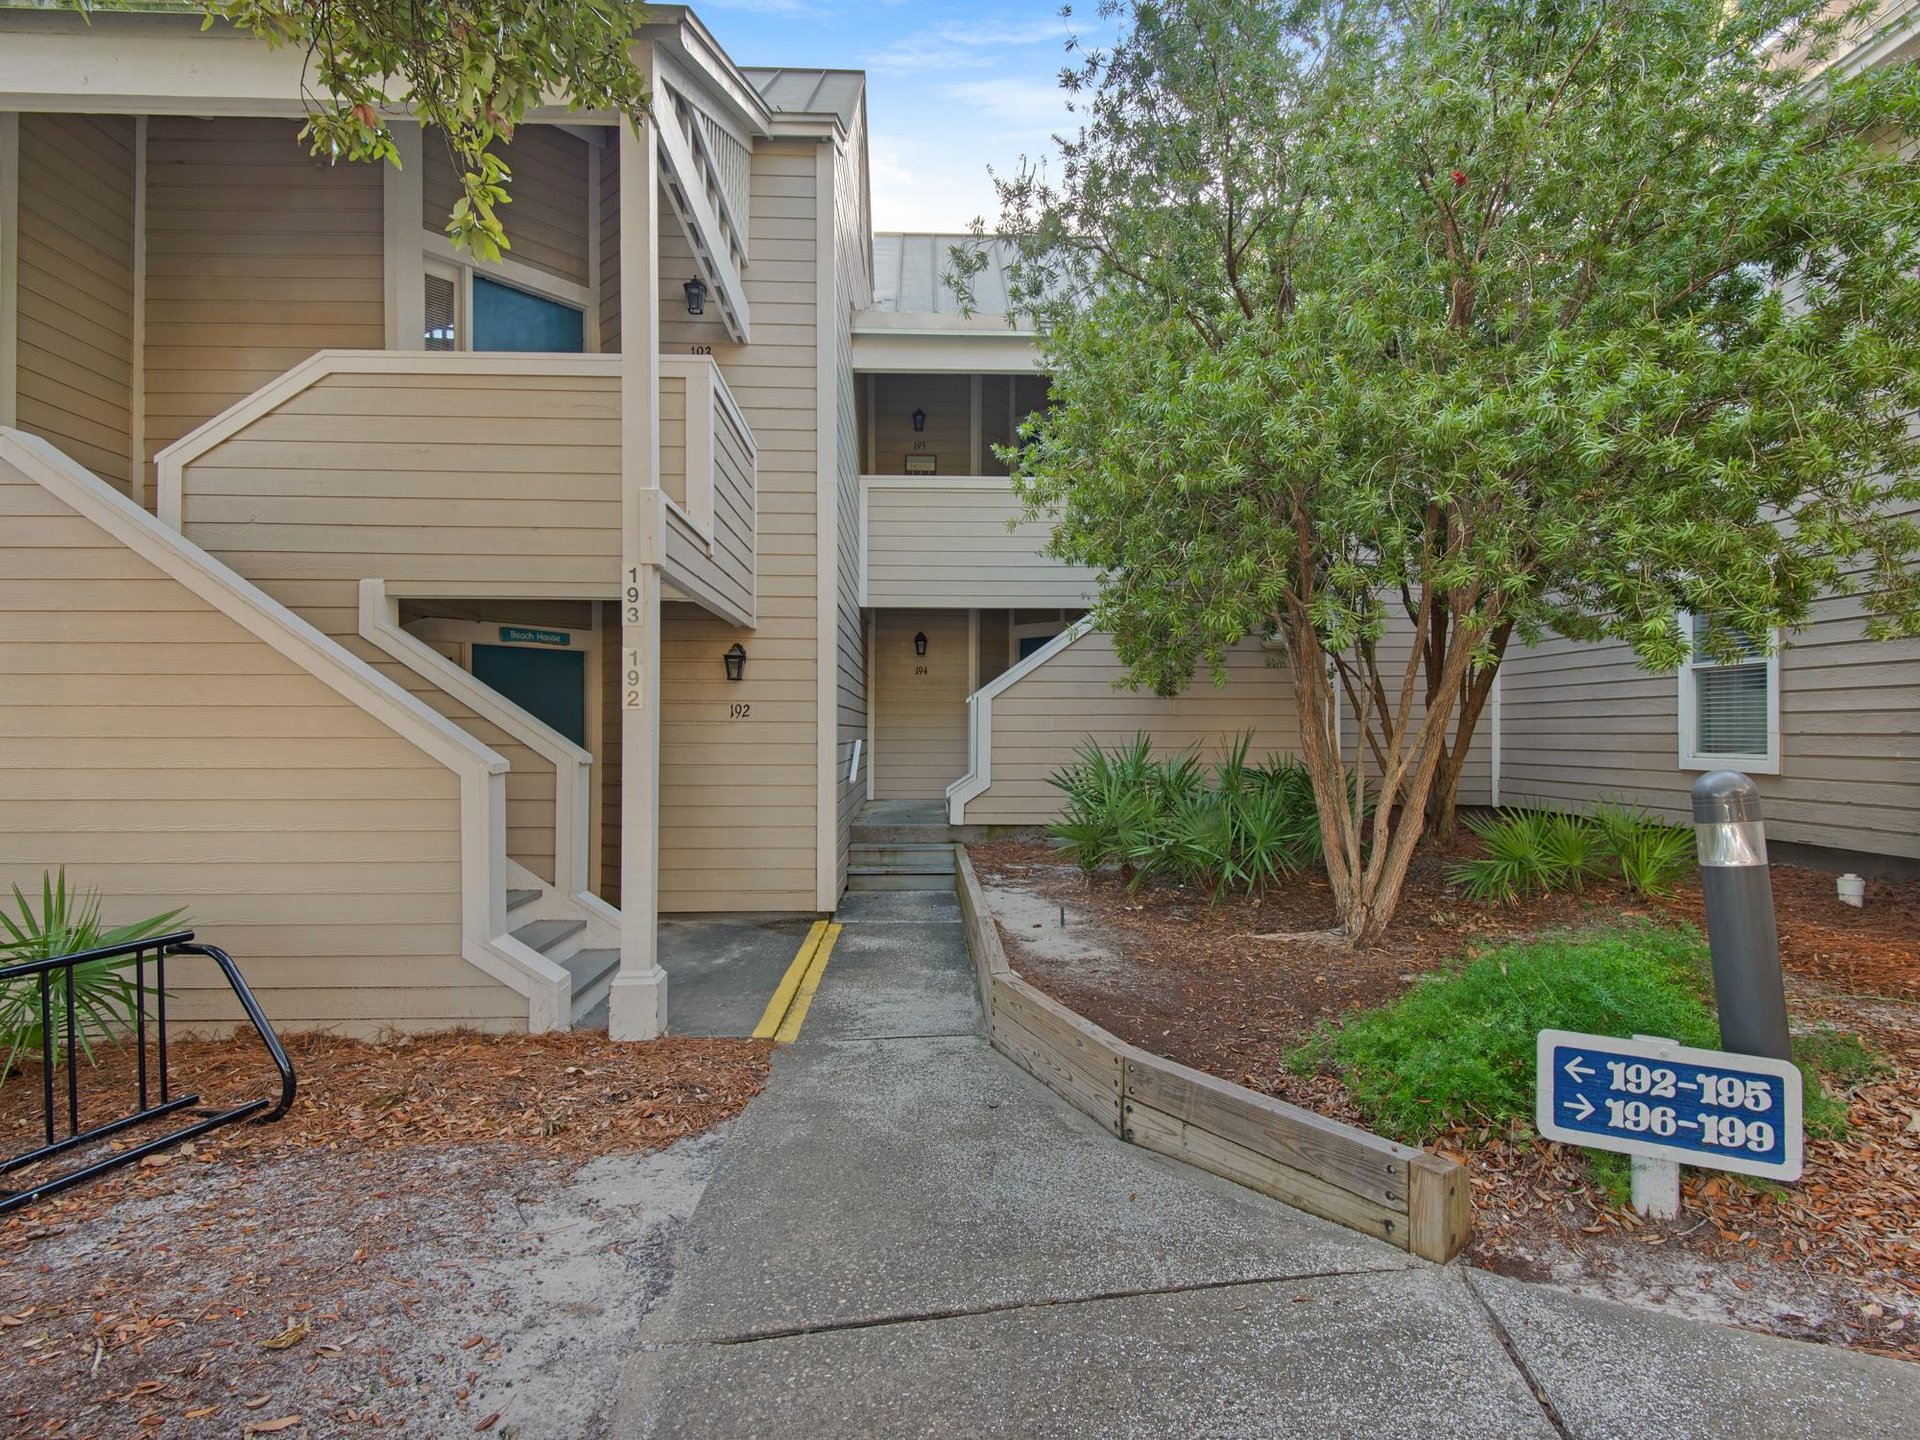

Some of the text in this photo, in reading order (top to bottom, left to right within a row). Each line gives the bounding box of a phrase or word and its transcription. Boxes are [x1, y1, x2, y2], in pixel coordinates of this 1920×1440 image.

[626, 567, 640, 623] 193
[510, 630, 561, 643] Beach House
[626, 650, 640, 707] 192
[914, 665, 928, 676] 194
[730, 703, 751, 719] 192
[1606, 1060, 1773, 1112] 192-195
[1604, 1097, 1775, 1153] 196-199
